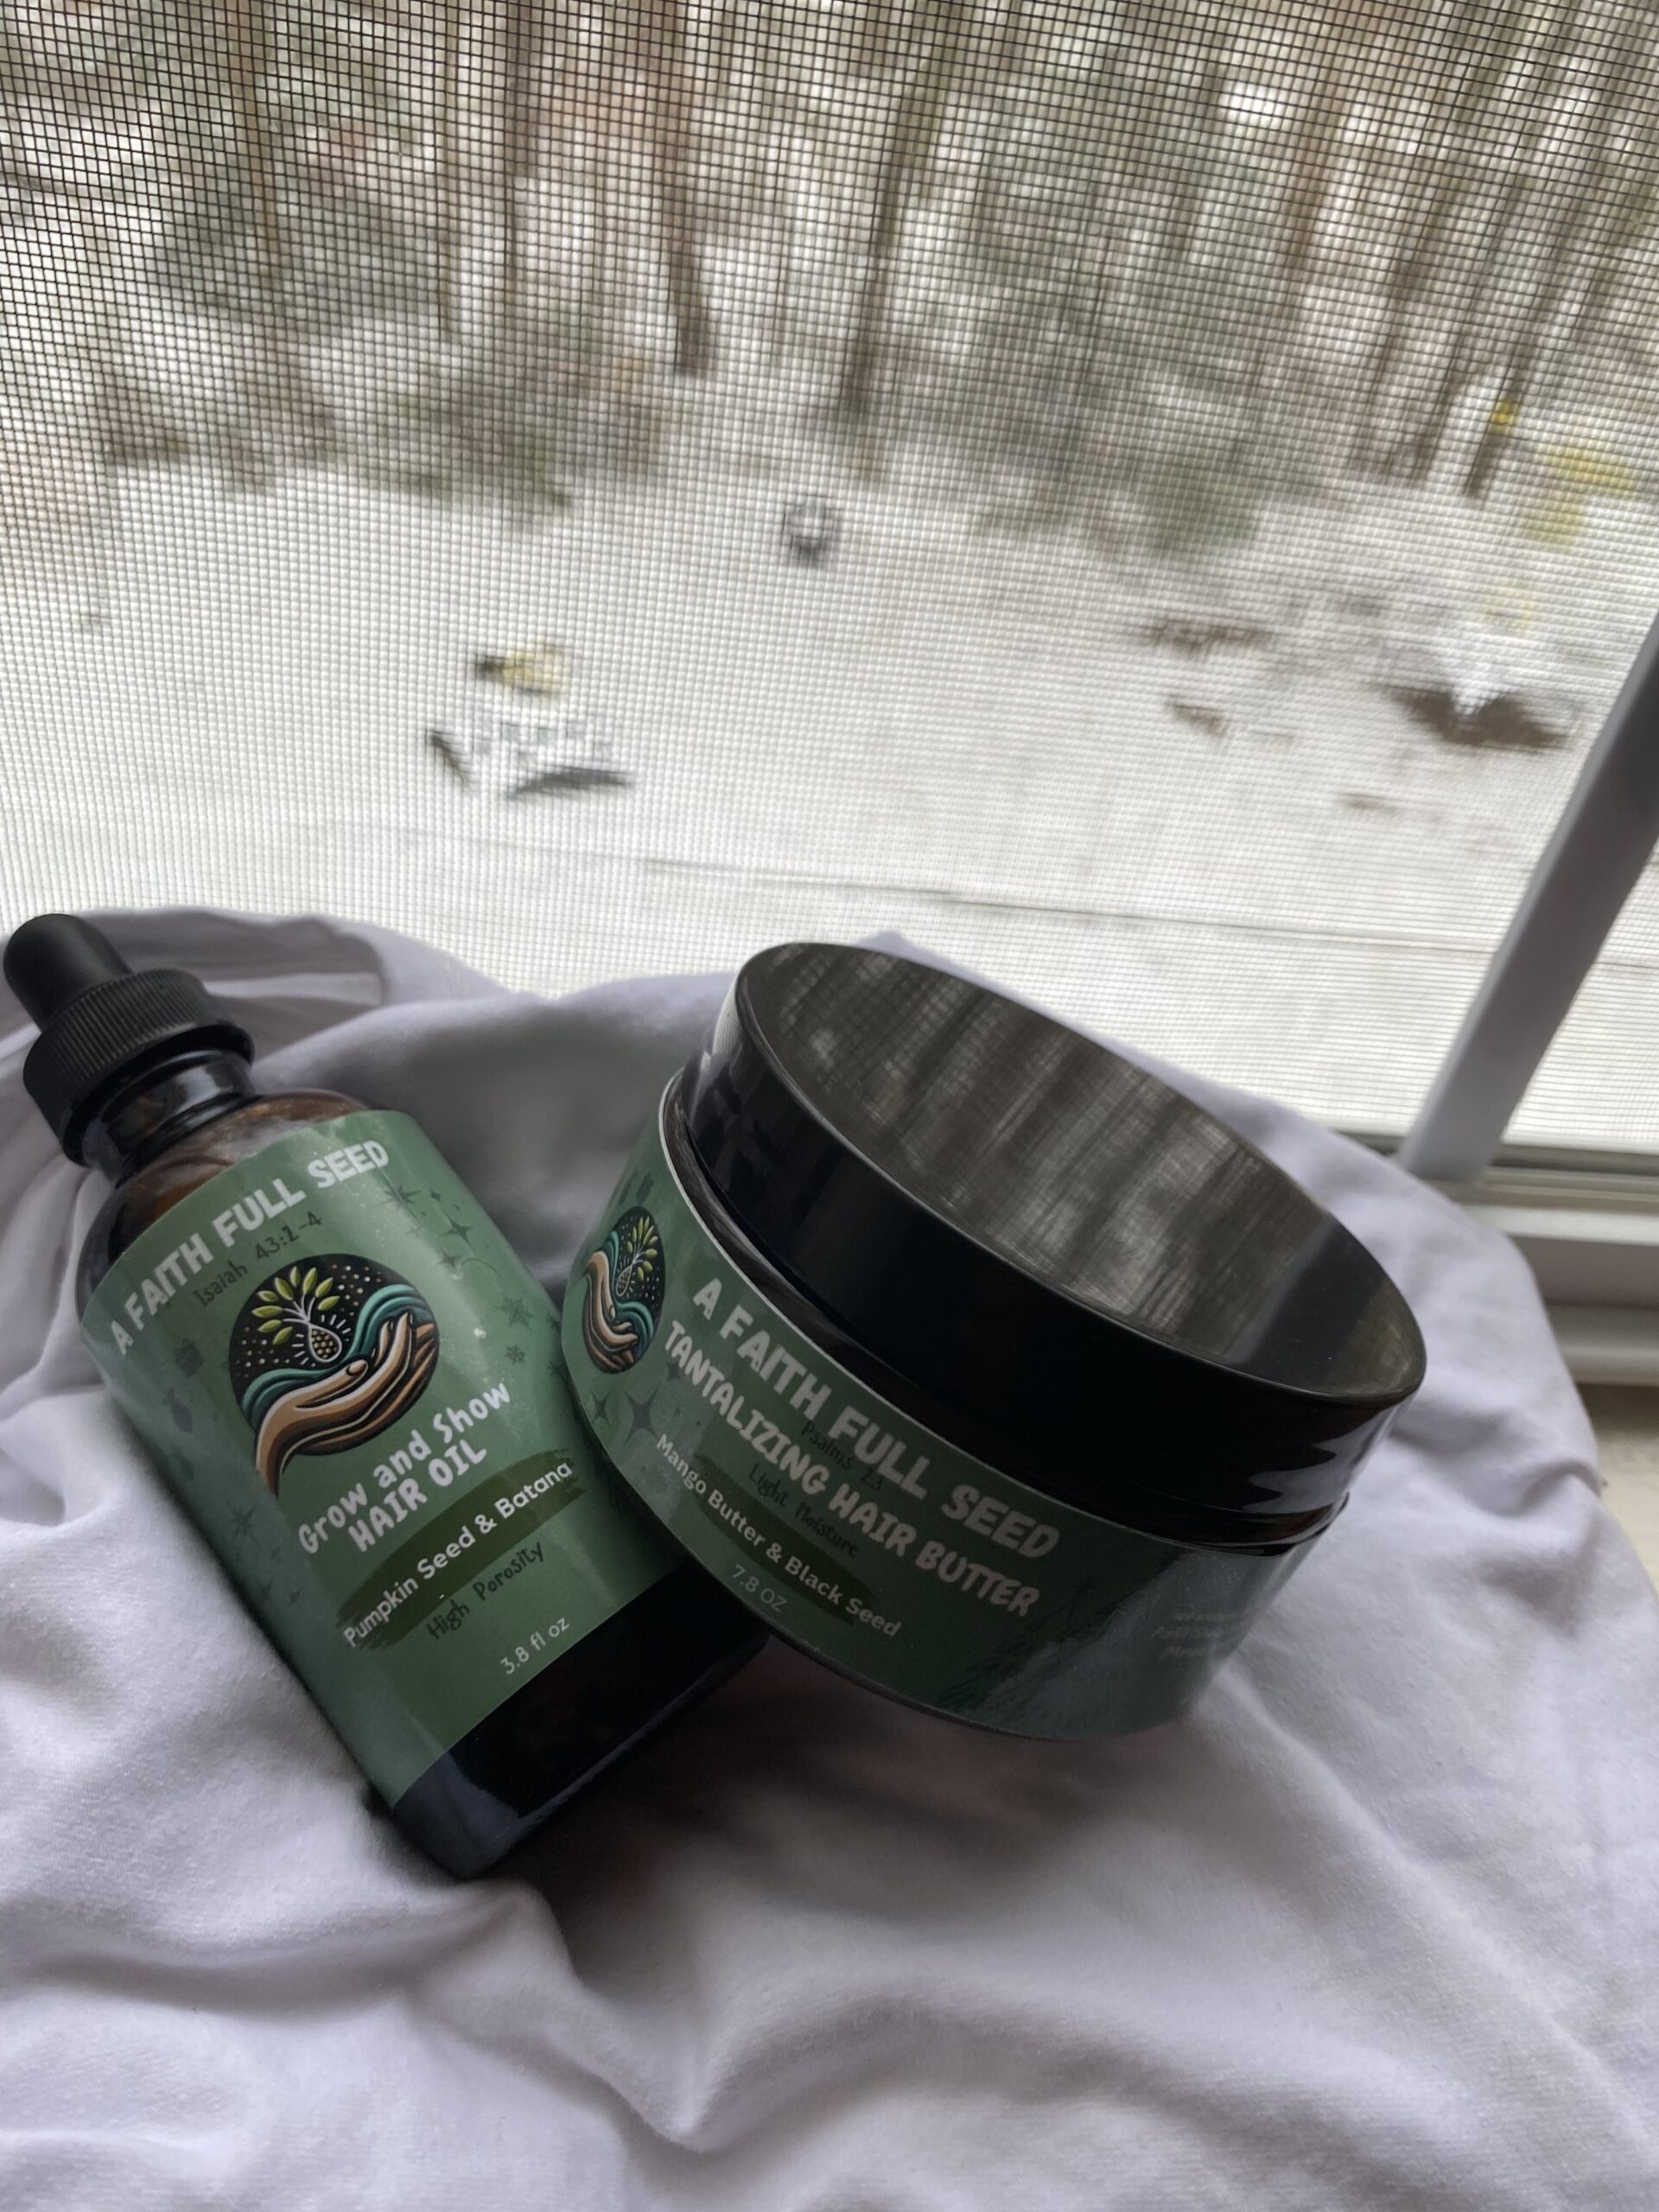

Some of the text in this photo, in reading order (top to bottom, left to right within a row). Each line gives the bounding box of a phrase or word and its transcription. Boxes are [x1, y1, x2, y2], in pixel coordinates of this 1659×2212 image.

[111, 1140, 389, 1357] A FAITH FULL SEED
[193, 1259, 249, 1307] Isaiah
[298, 1382, 511, 1554] Grow and Show
[664, 1320, 1041, 1617] TANTALIZING HAIR BUTTER
[693, 1278, 1060, 1558] A FAITH FULL SEED
[801, 1420, 854, 1471] Psalms
[348, 1439, 487, 1553] HAIR OIL
[656, 1433, 902, 1637] Mango Butter & Black Seed
[749, 1462, 861, 1558] Light Moisture
[344, 1462, 573, 1648] Pumpkin Seed & Batana
[426, 1541, 544, 1640] High Porosity
[732, 1564, 787, 1613] 7.8 OZ
[500, 1618, 570, 1675] 3.8 fl oz
